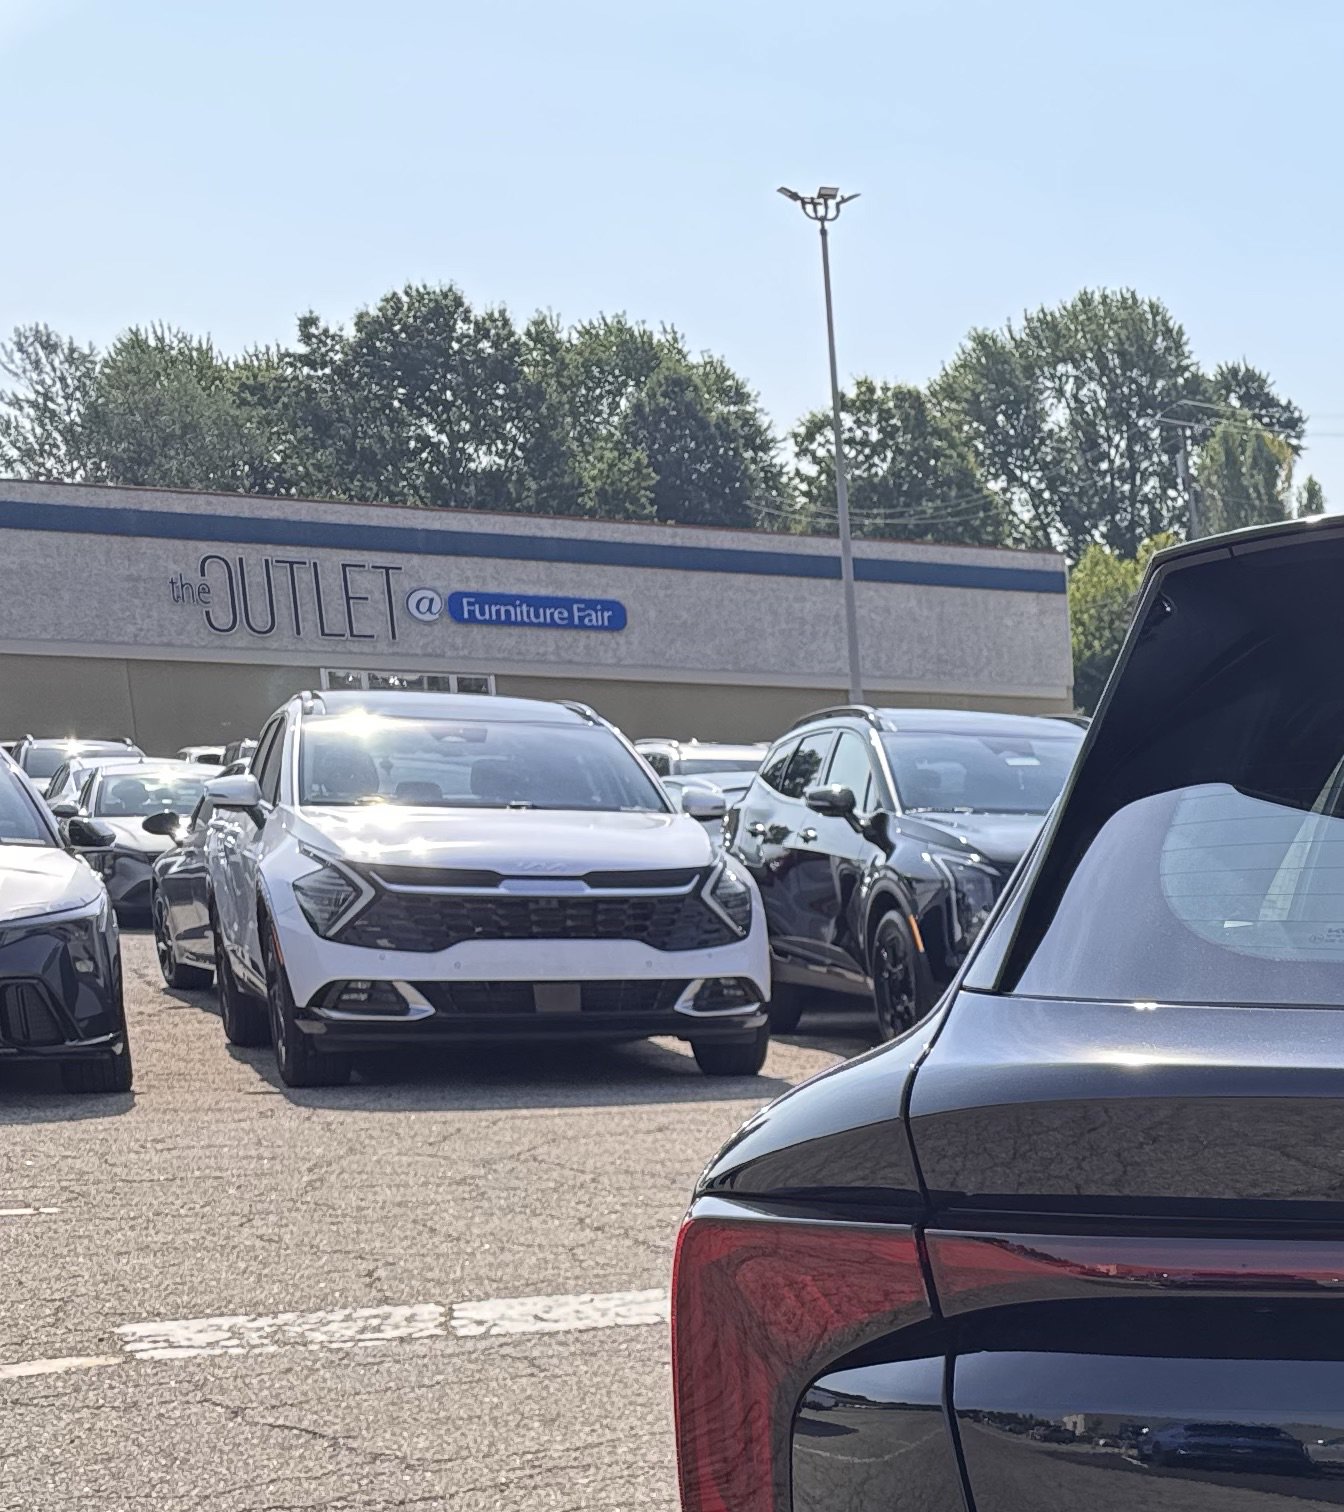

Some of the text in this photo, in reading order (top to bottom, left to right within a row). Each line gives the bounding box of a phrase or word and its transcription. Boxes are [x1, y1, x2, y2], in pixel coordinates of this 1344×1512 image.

[168, 573, 211, 605] the
[199, 554, 403, 641] OUTLET
[462, 597, 569, 625] Furniture
[572, 604, 612, 626] Fair
